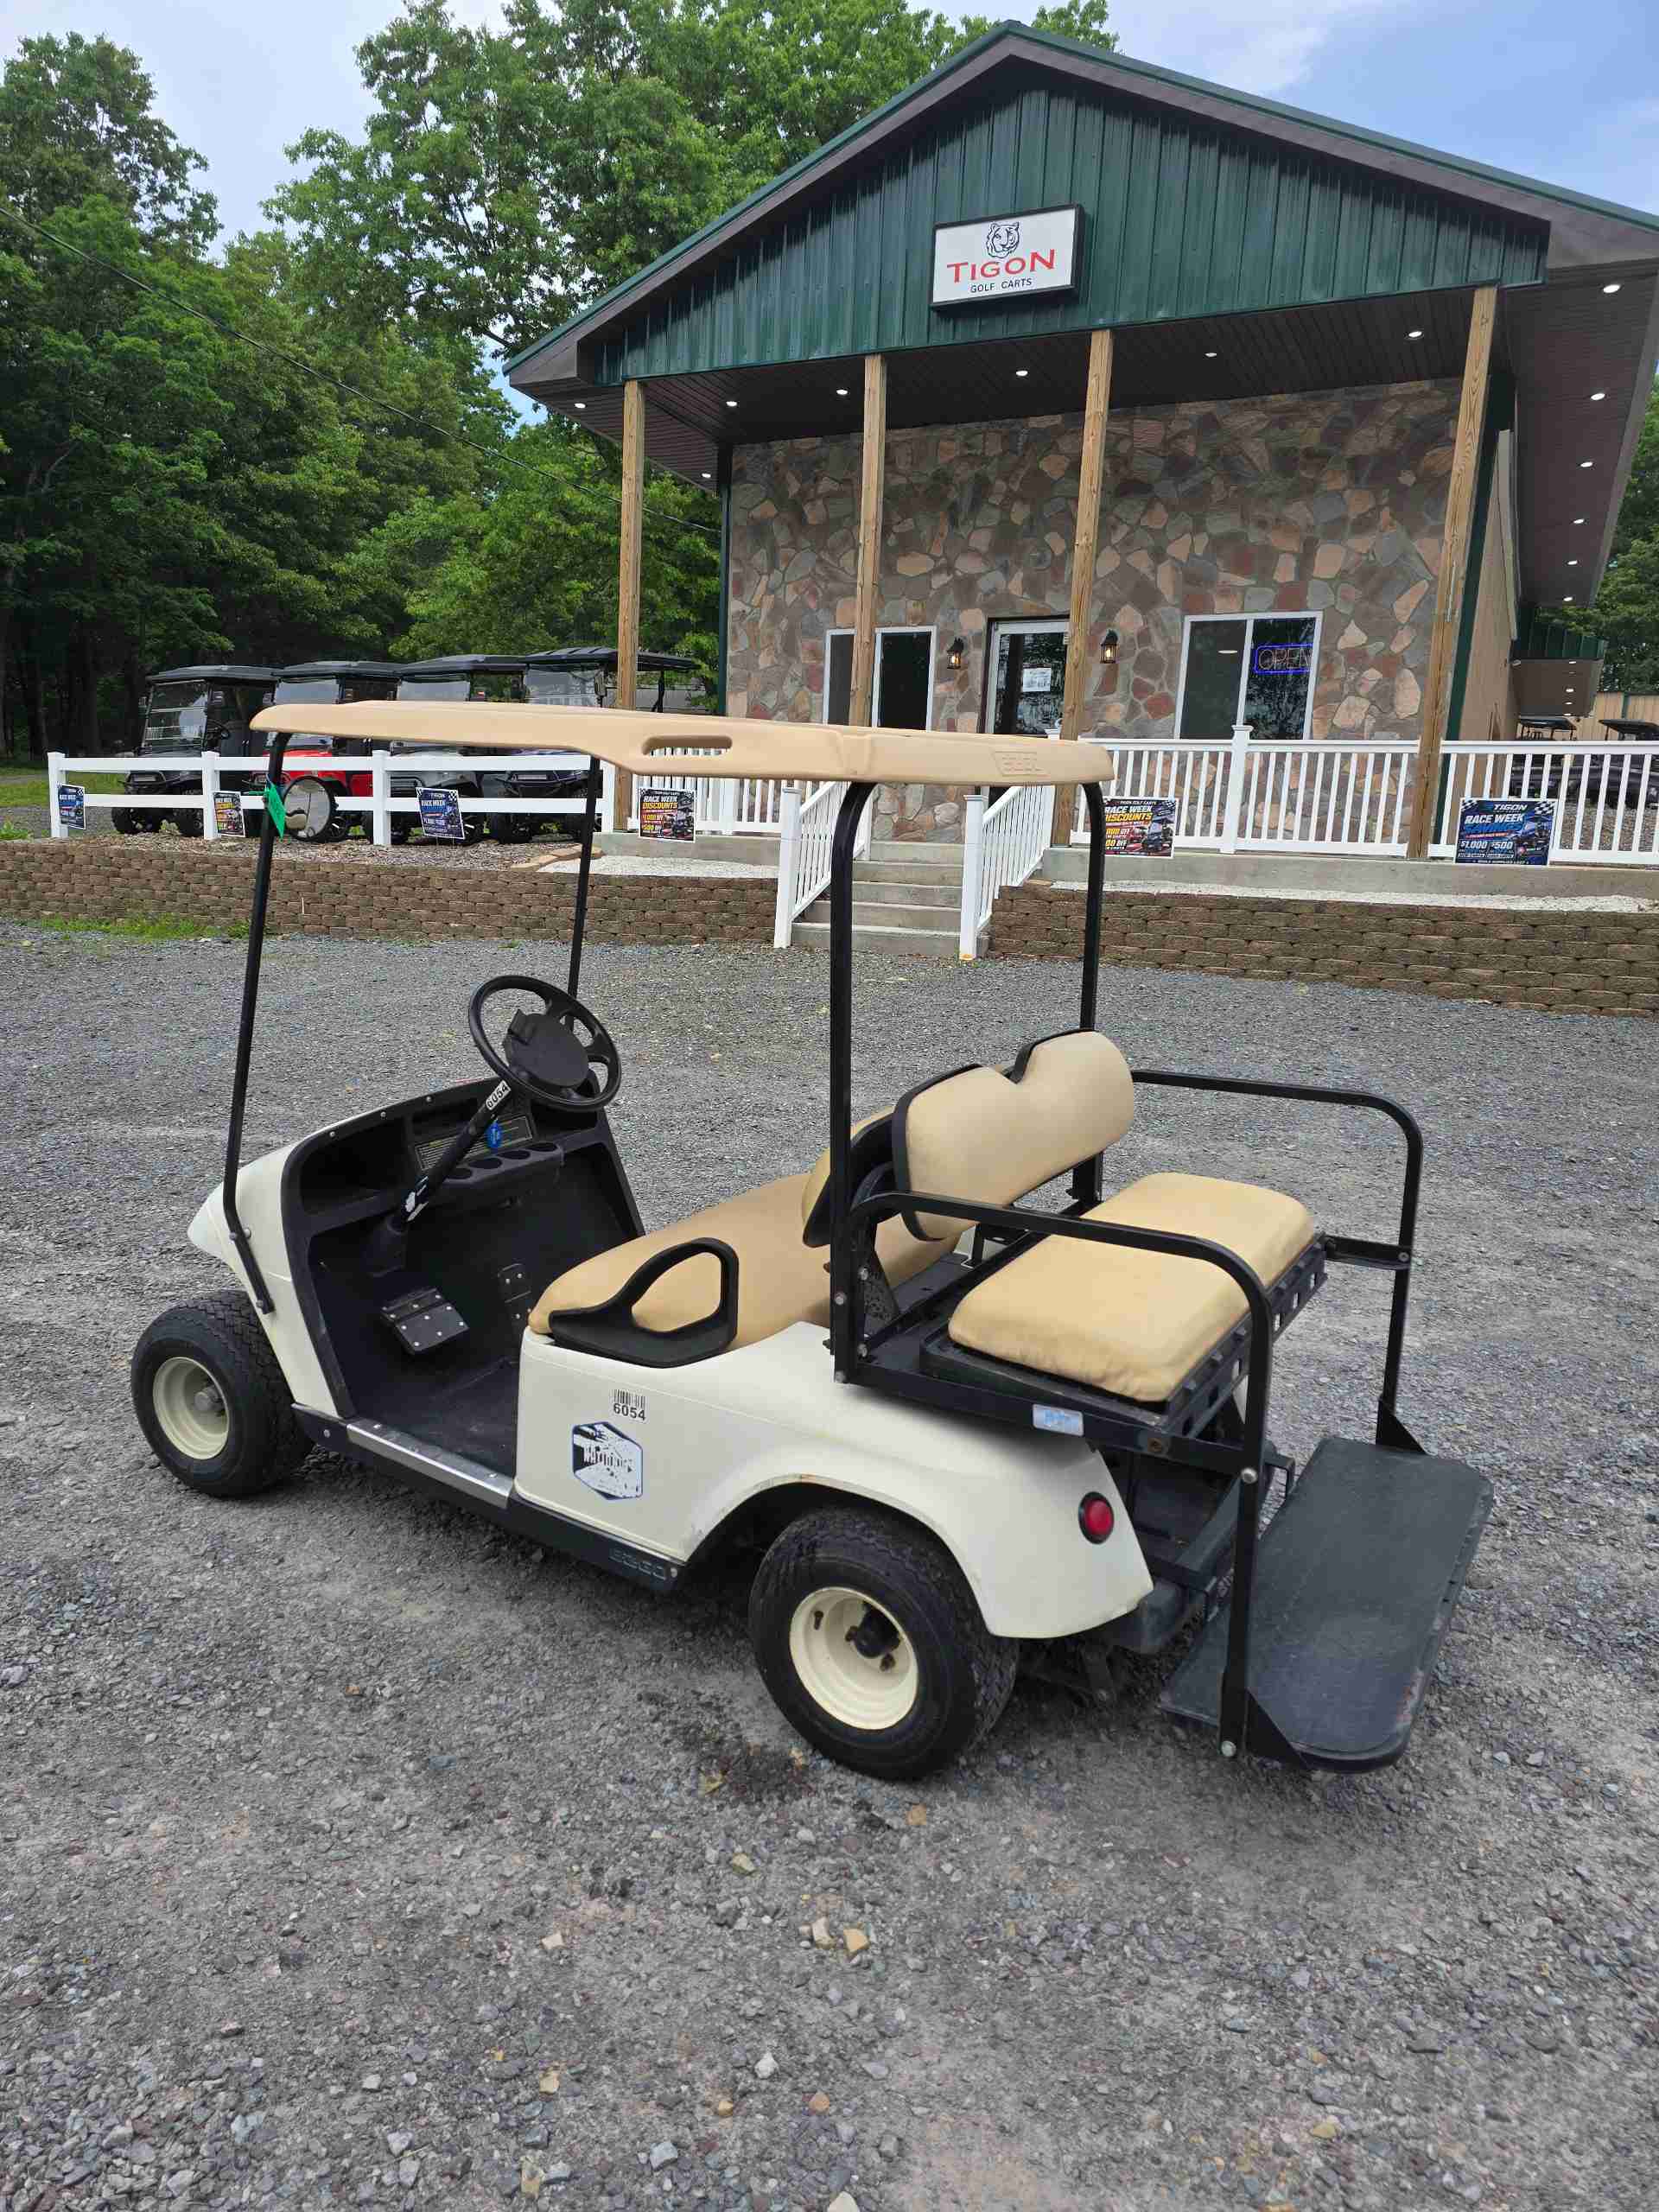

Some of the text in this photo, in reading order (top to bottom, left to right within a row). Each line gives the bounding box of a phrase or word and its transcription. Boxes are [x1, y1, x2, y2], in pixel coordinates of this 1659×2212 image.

[946, 249, 1055, 283] TIGON
[970, 277, 1033, 293] GOLF CARTS
[1258, 648, 1313, 670] OPEN
[1465, 814, 1523, 823] RACE WEEK
[487, 1083, 510, 1108] 6054
[613, 1402, 646, 1421] 6054
